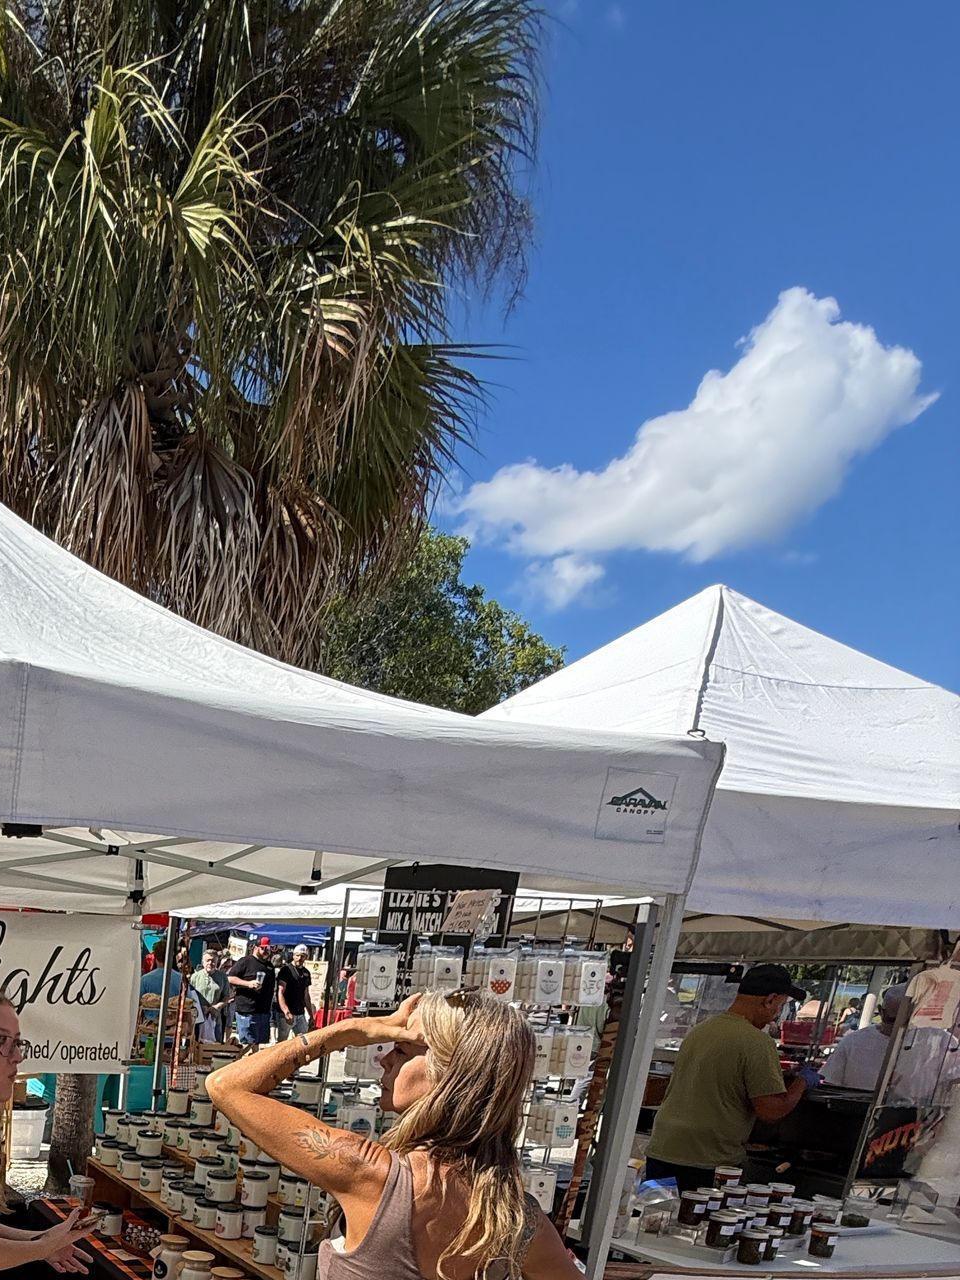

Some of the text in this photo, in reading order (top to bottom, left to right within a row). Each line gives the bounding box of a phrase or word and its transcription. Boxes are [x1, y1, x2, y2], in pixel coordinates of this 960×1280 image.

[606, 796, 668, 811] CARAVAN
[616, 807, 656, 816] CANOPY
[386, 911, 443, 932] MIX & MATCH
[25, 1039, 122, 1065] ned/operated.
